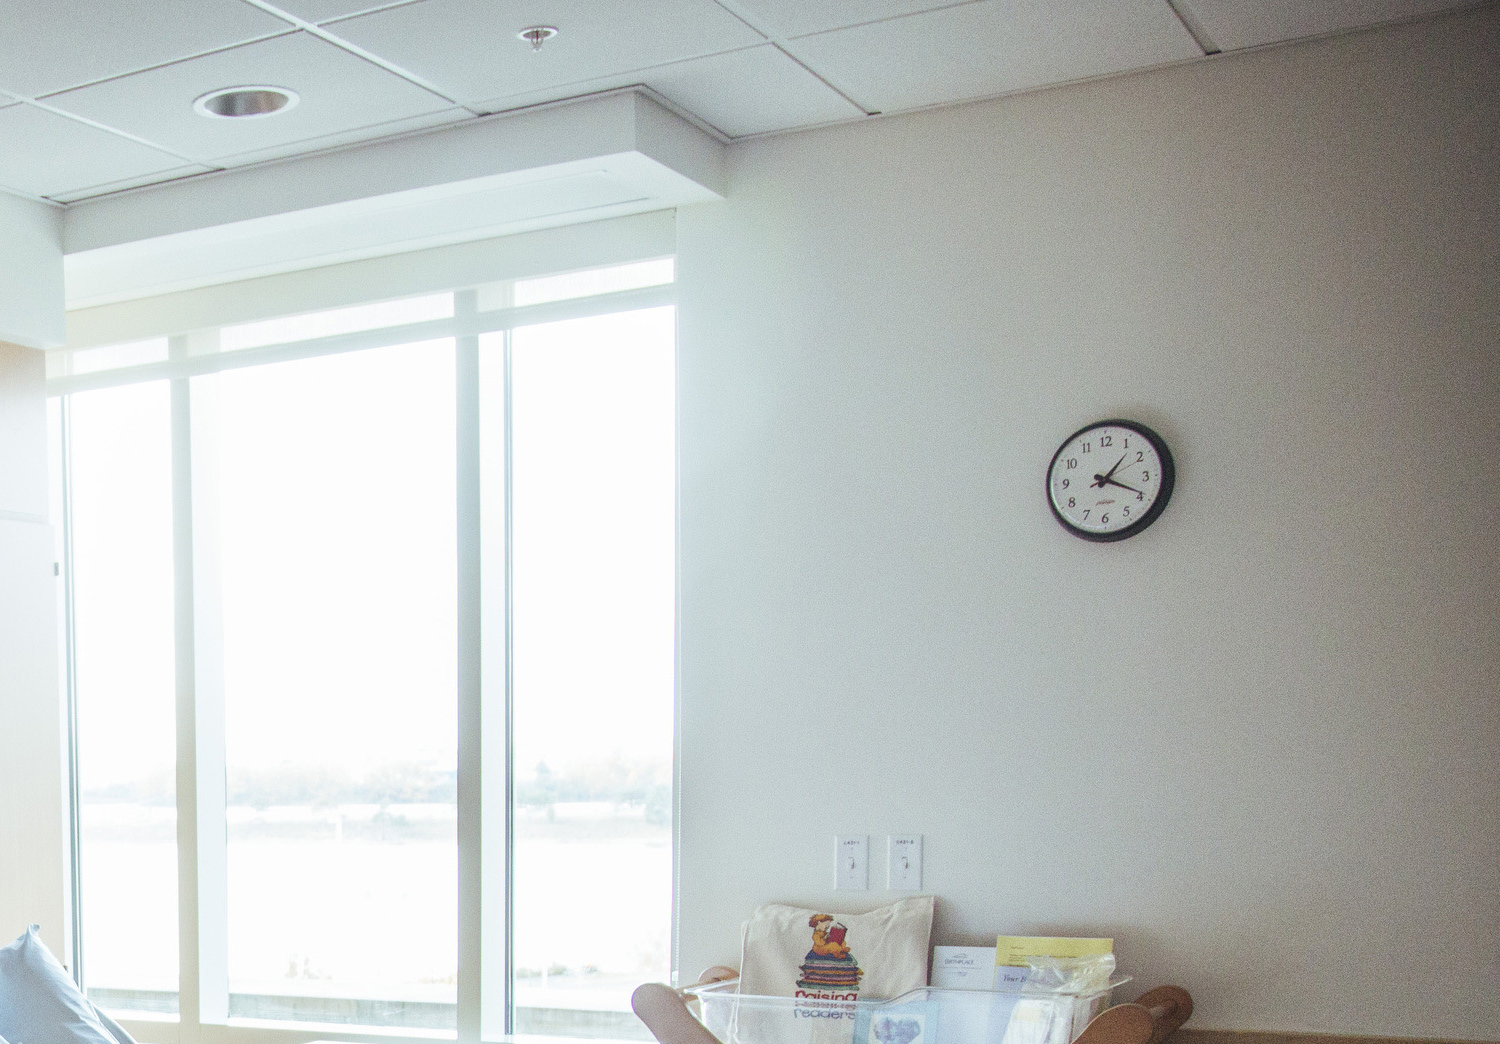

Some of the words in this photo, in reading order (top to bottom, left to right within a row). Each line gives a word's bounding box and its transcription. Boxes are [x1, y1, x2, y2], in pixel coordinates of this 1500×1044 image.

[1100, 436, 1112, 447] 12
[1082, 442, 1091, 453] 11
[1136, 451, 1144, 462] 2
[1066, 458, 1077, 469] 10
[1142, 471, 1149, 482] 3
[1062, 478, 1070, 490] 9
[1136, 491, 1144, 501] 4
[1068, 497, 1076, 508] 8
[1082, 509, 1090, 520] 7
[1123, 506, 1130, 516] 5
[1101, 513, 1109, 523] 6
